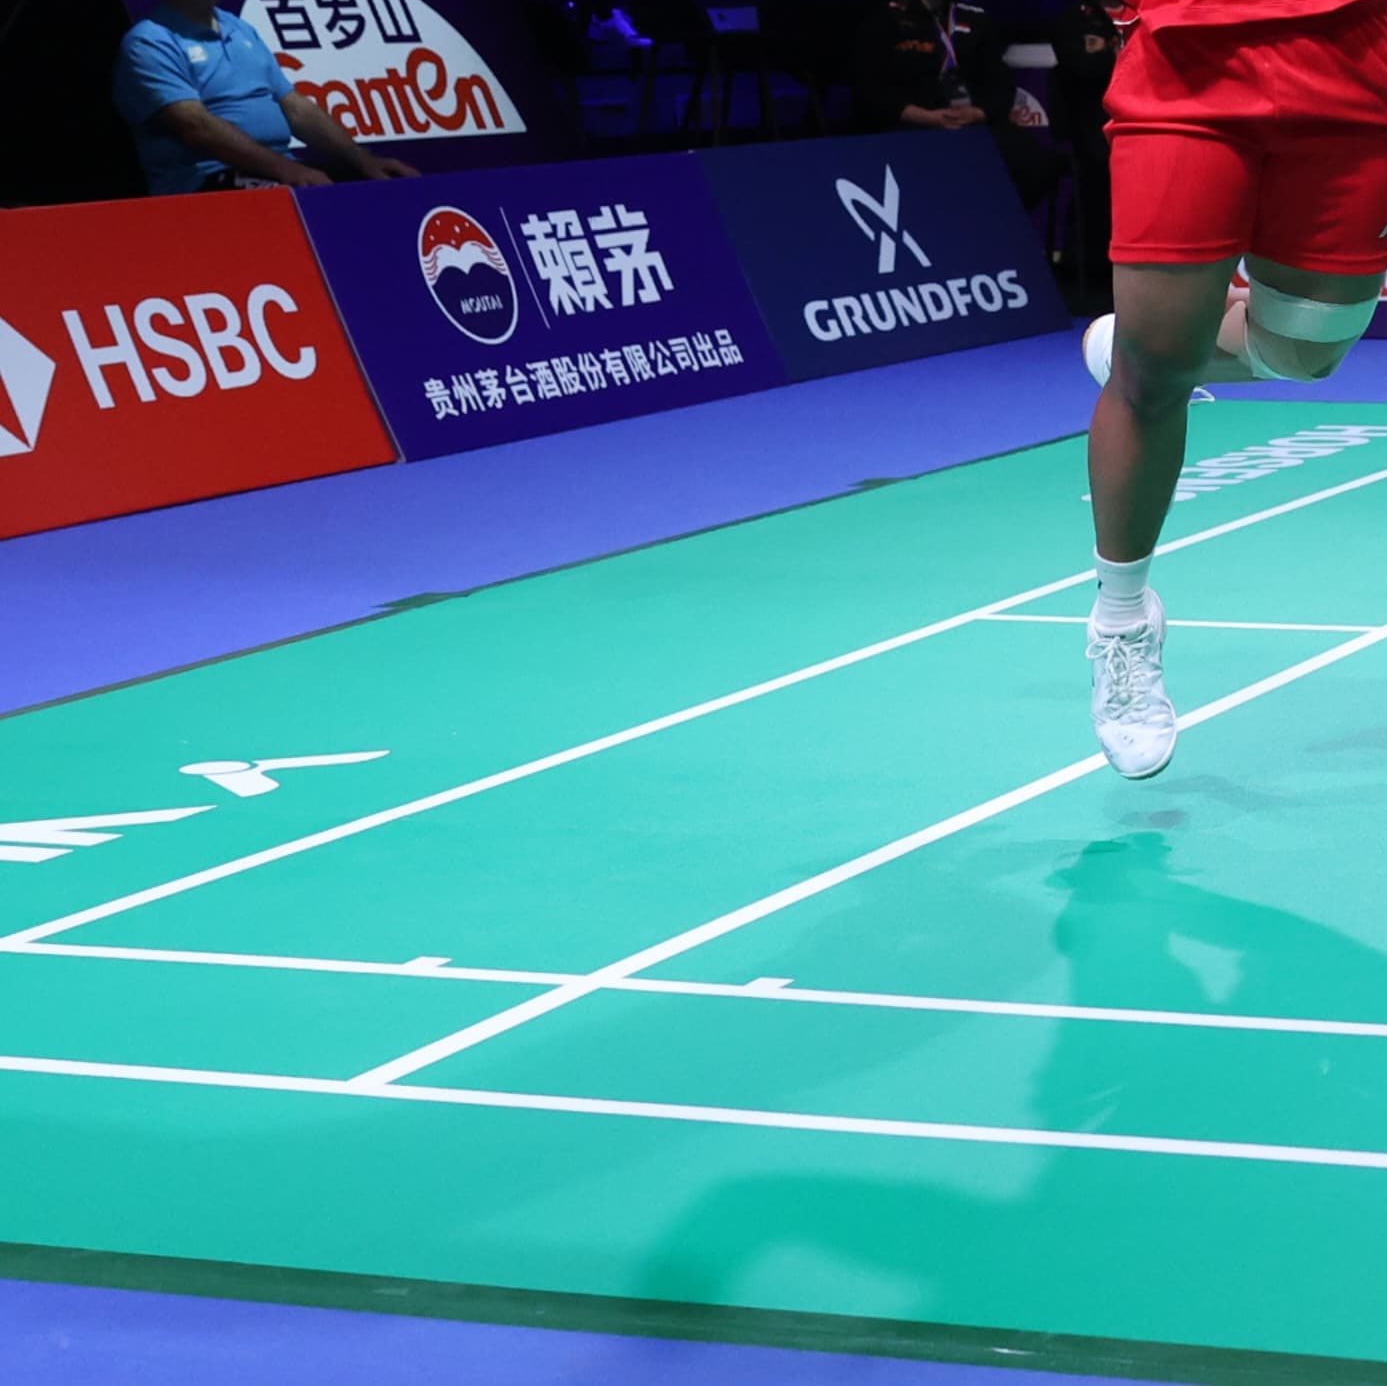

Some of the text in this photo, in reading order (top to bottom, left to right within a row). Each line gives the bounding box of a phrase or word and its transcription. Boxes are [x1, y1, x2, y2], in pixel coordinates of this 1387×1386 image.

[61, 283, 318, 411] HSBC
[803, 268, 1029, 343] GRUNDFOS
[424, 327, 744, 421] 贵州茅台酒股份有限公司出品
